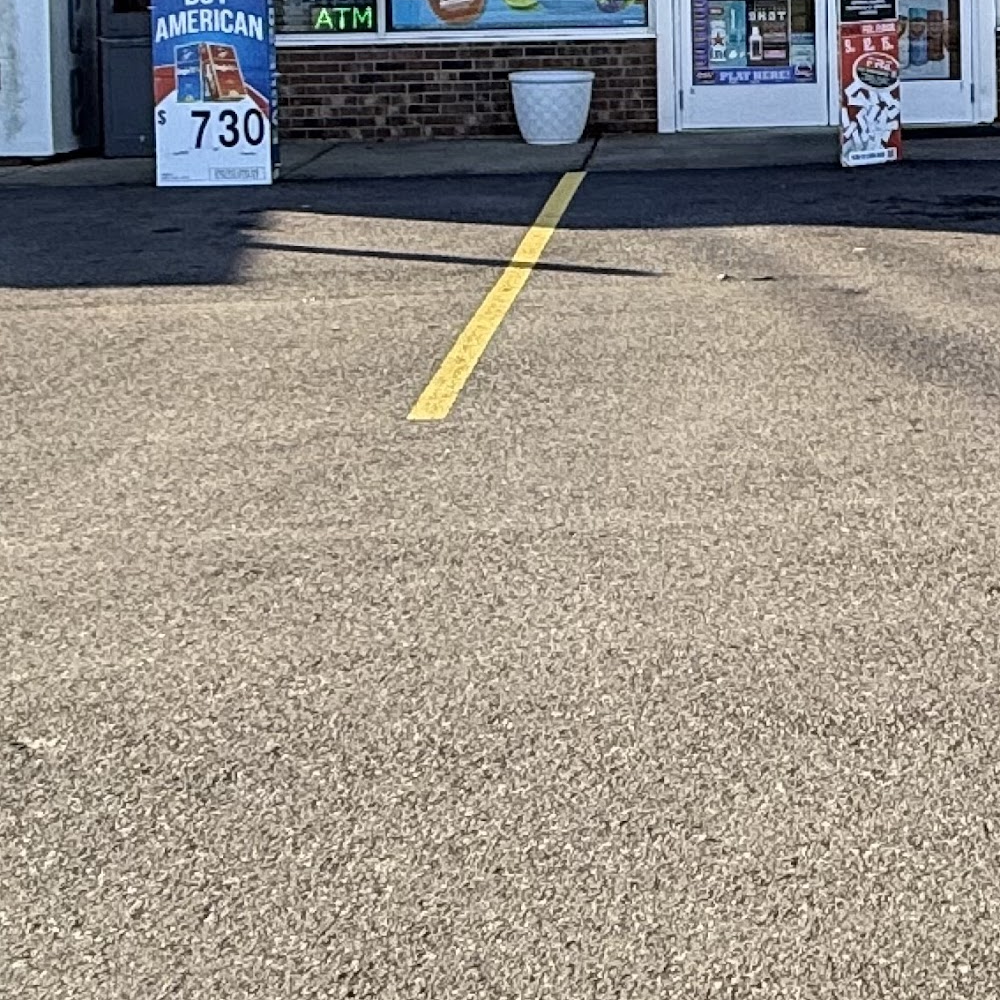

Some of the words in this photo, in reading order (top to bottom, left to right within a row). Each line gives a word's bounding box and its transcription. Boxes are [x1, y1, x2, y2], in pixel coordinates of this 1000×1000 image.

[155, 9, 265, 43] AMERICAN
[313, 6, 373, 30] ATM
[158, 109, 167, 126] $
